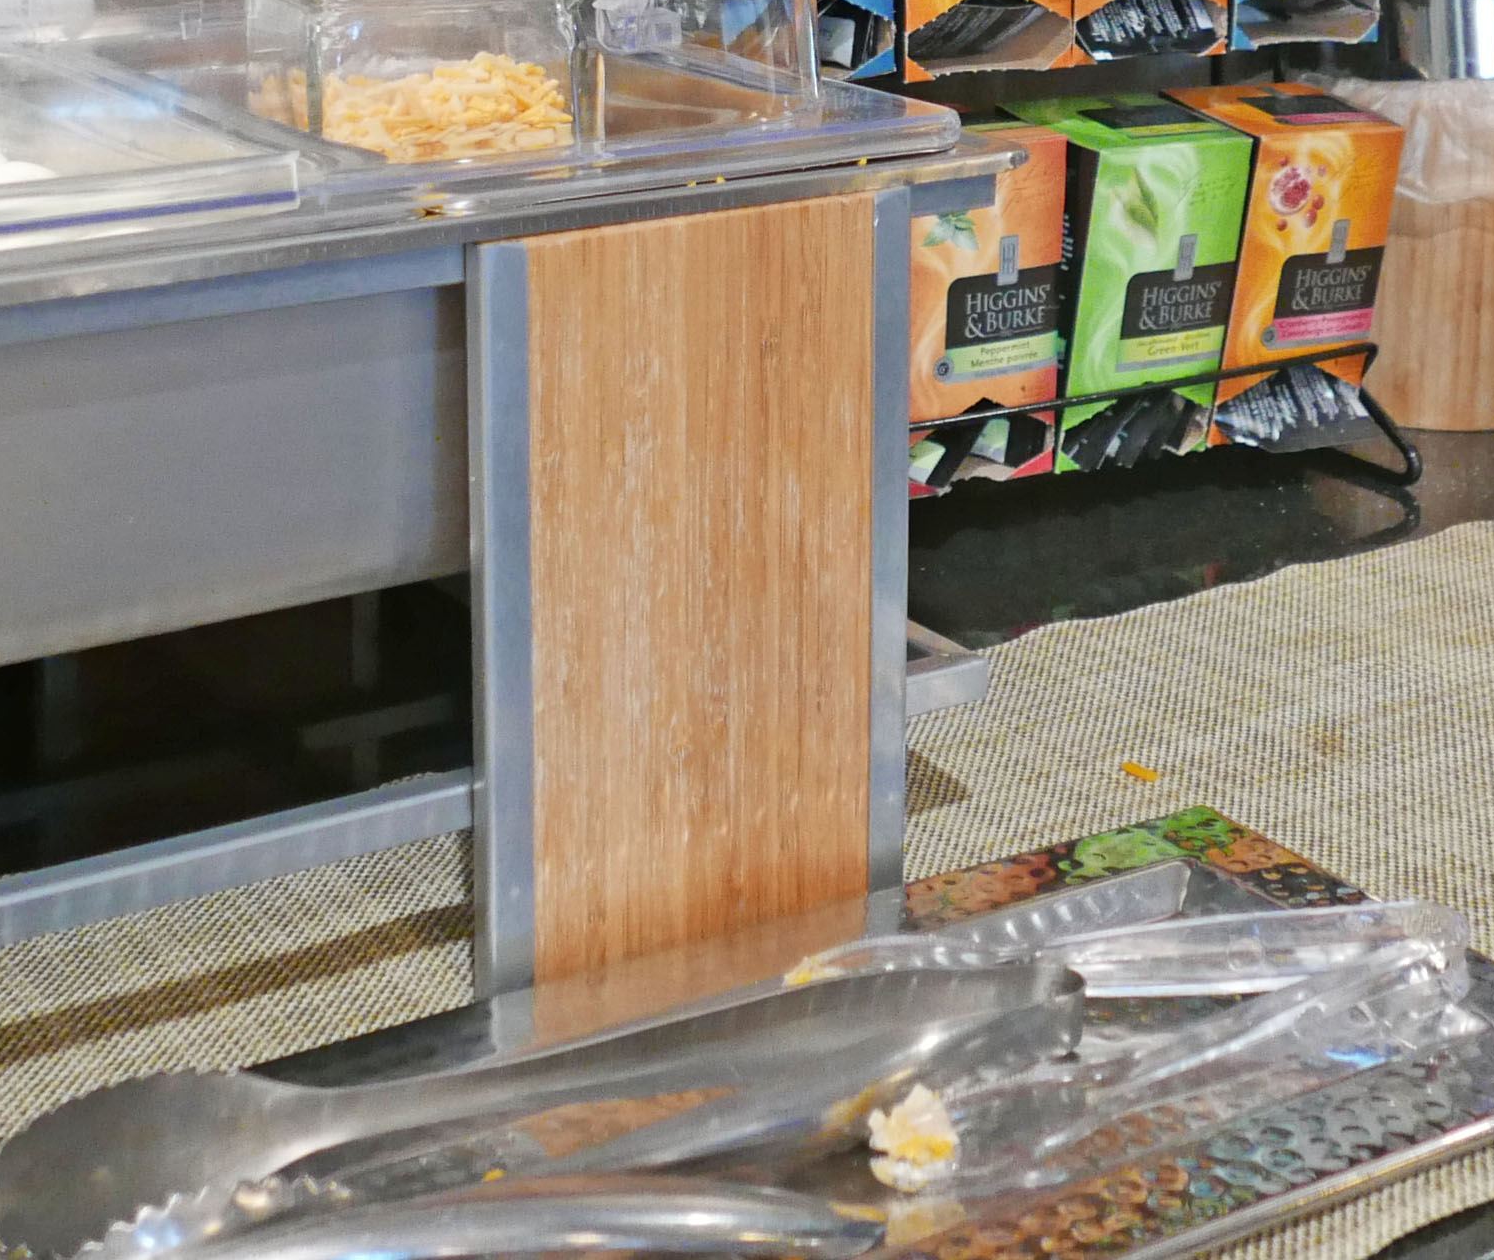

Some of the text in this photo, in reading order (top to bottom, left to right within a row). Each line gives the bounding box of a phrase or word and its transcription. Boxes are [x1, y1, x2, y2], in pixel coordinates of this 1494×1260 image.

[966, 284, 1048, 314] HIGGINS
[1142, 282, 1219, 307] HIGGINS
[965, 306, 1046, 338] & BURKE
[1139, 301, 1214, 330] & BURKE
